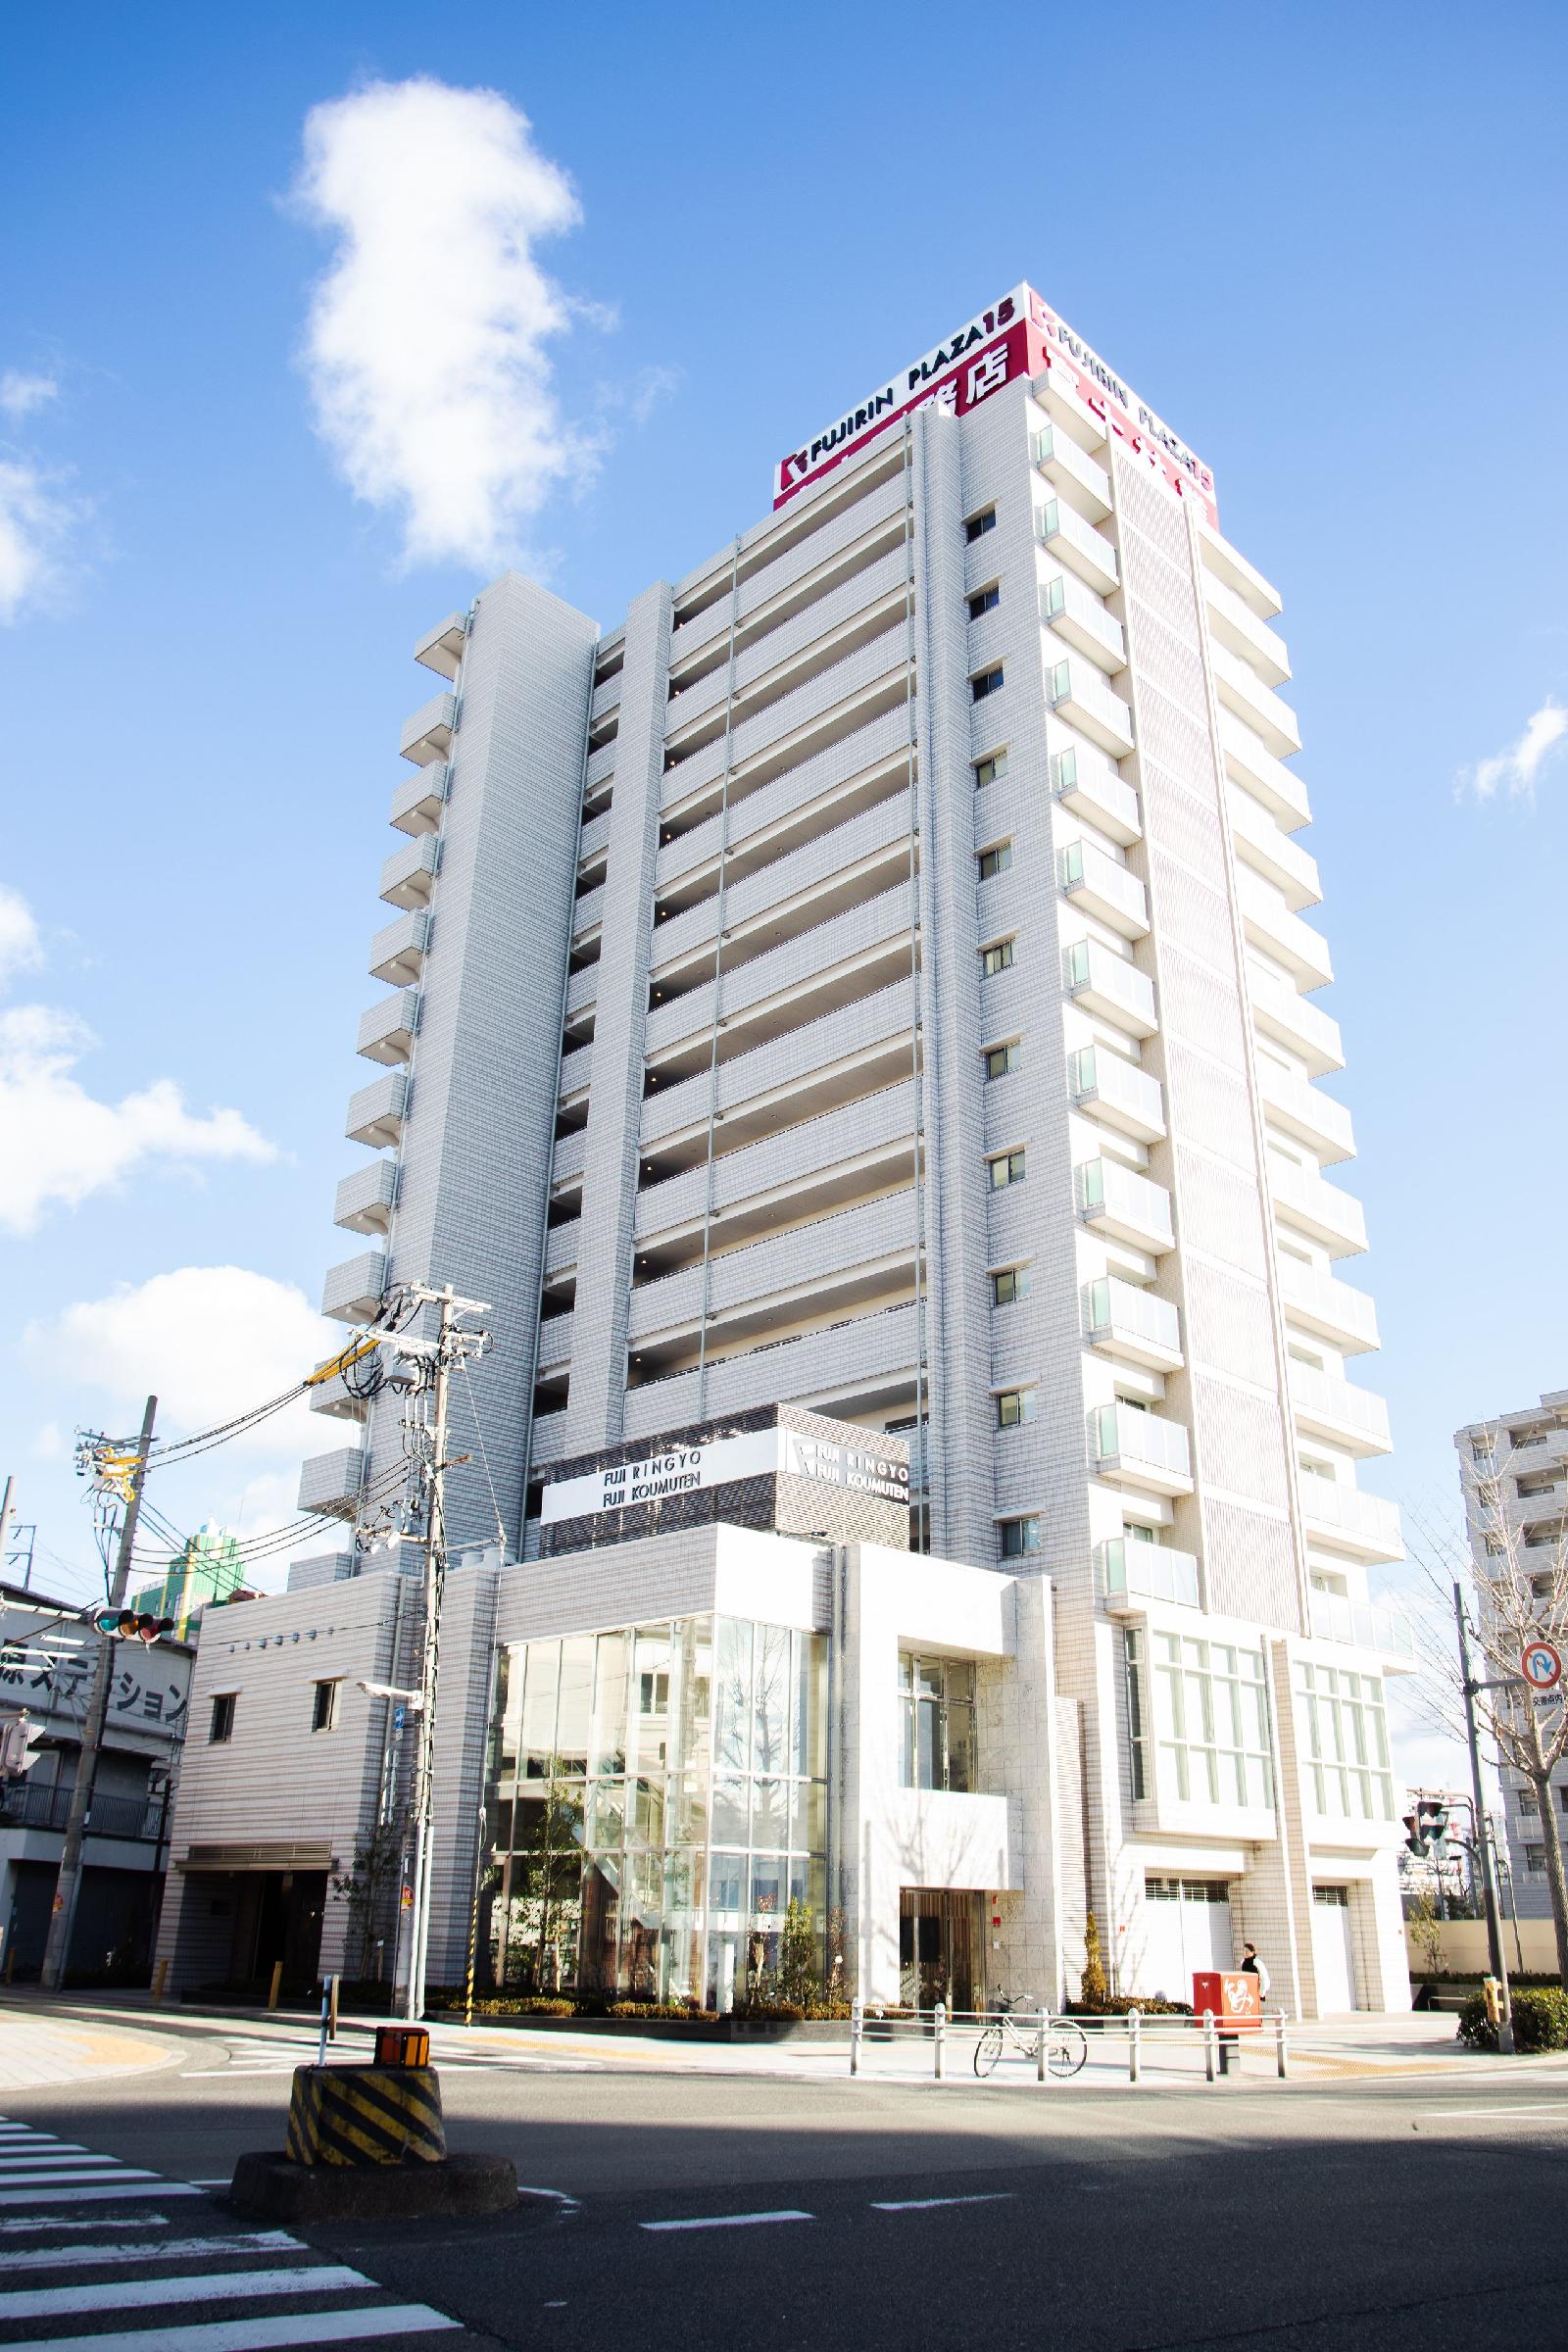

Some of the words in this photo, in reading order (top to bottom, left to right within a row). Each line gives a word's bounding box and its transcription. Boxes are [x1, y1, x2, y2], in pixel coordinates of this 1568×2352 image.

[1057, 324, 1128, 409] FUJIRIN
[811, 387, 893, 463] FUJIRIN
[604, 1468, 626, 1487] FUJI
[632, 1450, 701, 1480] RINGYO
[816, 1444, 840, 1463] FUJI
[846, 1452, 909, 1482] RINGYO
[816, 1463, 840, 1482] FUJI
[845, 1471, 909, 1501] KOUMUTEN
[603, 1490, 625, 1507] FUJI
[631, 1471, 701, 1501] KOUMUTEN
